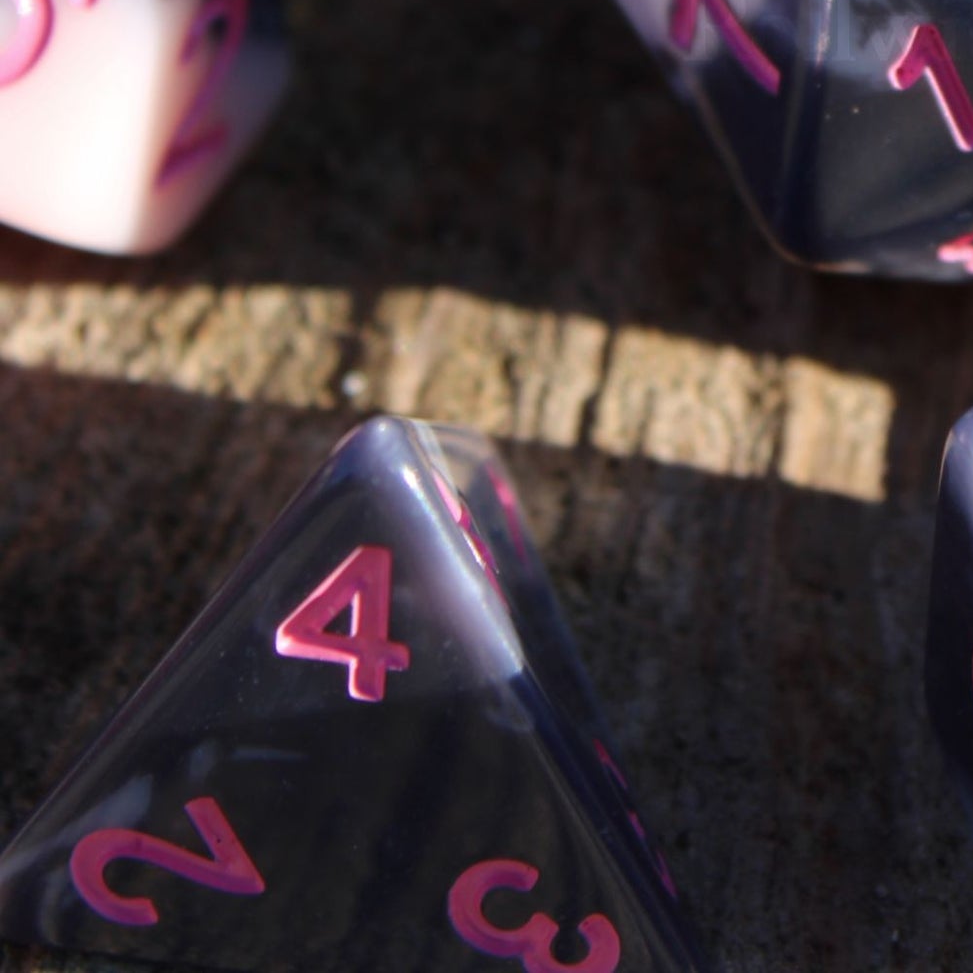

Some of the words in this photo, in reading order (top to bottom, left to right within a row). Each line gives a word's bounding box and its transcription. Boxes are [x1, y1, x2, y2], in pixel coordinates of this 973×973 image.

[275, 545, 410, 702] 4
[69, 796, 265, 925] 2
[448, 858, 621, 973] 3
